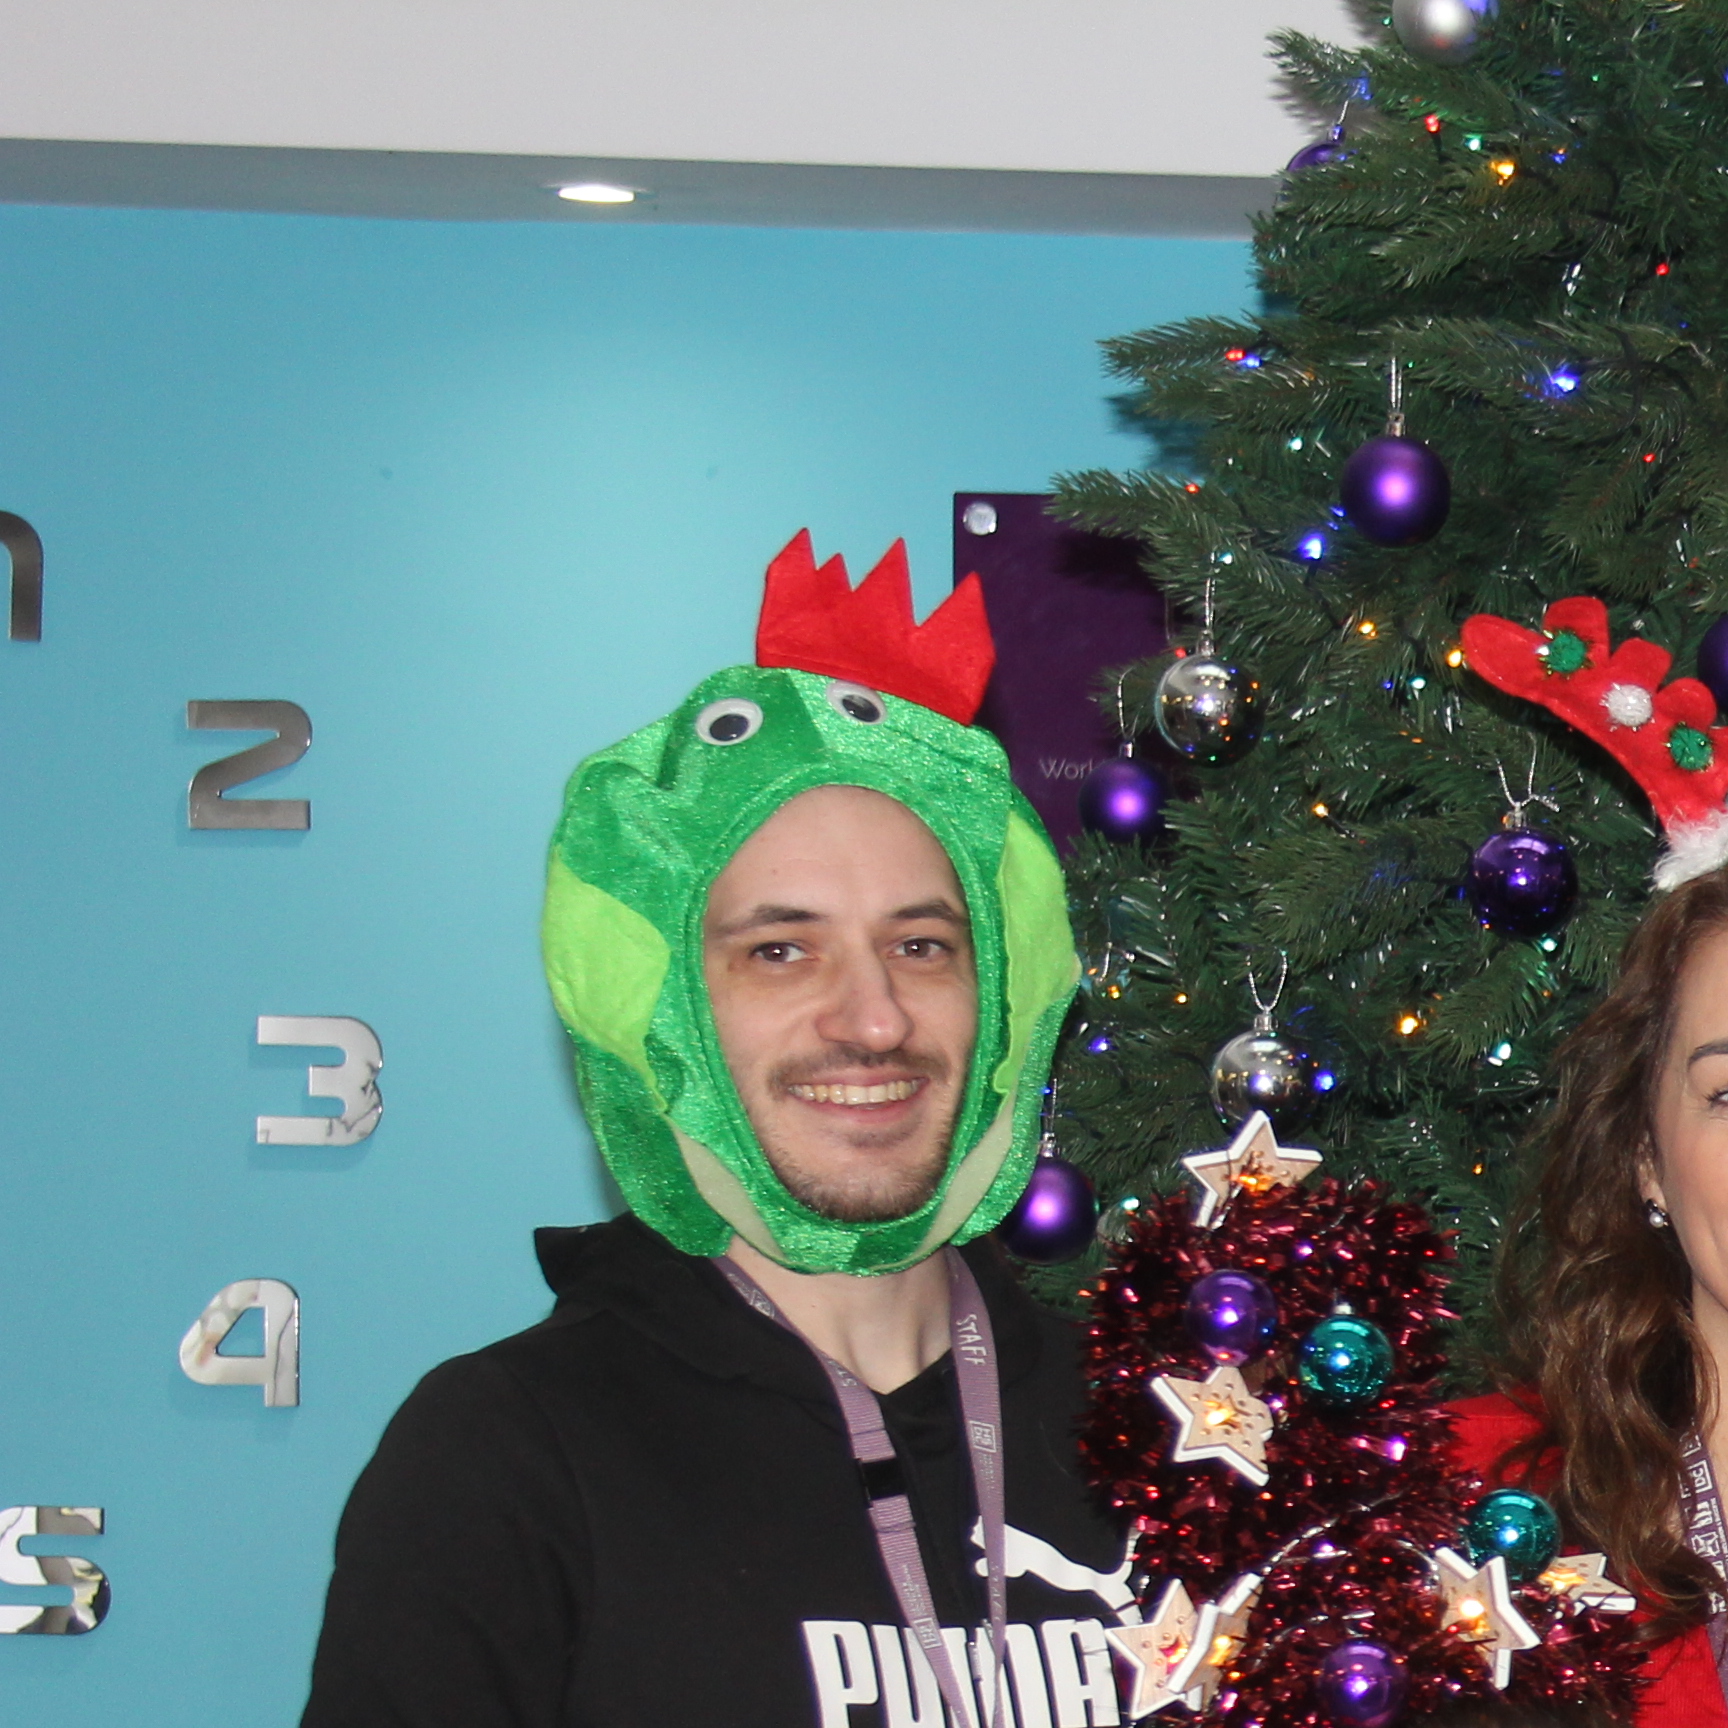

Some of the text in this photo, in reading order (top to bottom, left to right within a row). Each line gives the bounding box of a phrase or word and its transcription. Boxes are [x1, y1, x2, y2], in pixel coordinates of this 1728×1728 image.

[187, 699, 312, 829] 2
[256, 1015, 384, 1145] 3
[180, 1278, 300, 1407] 4
[956, 1314, 987, 1366] STAFF
